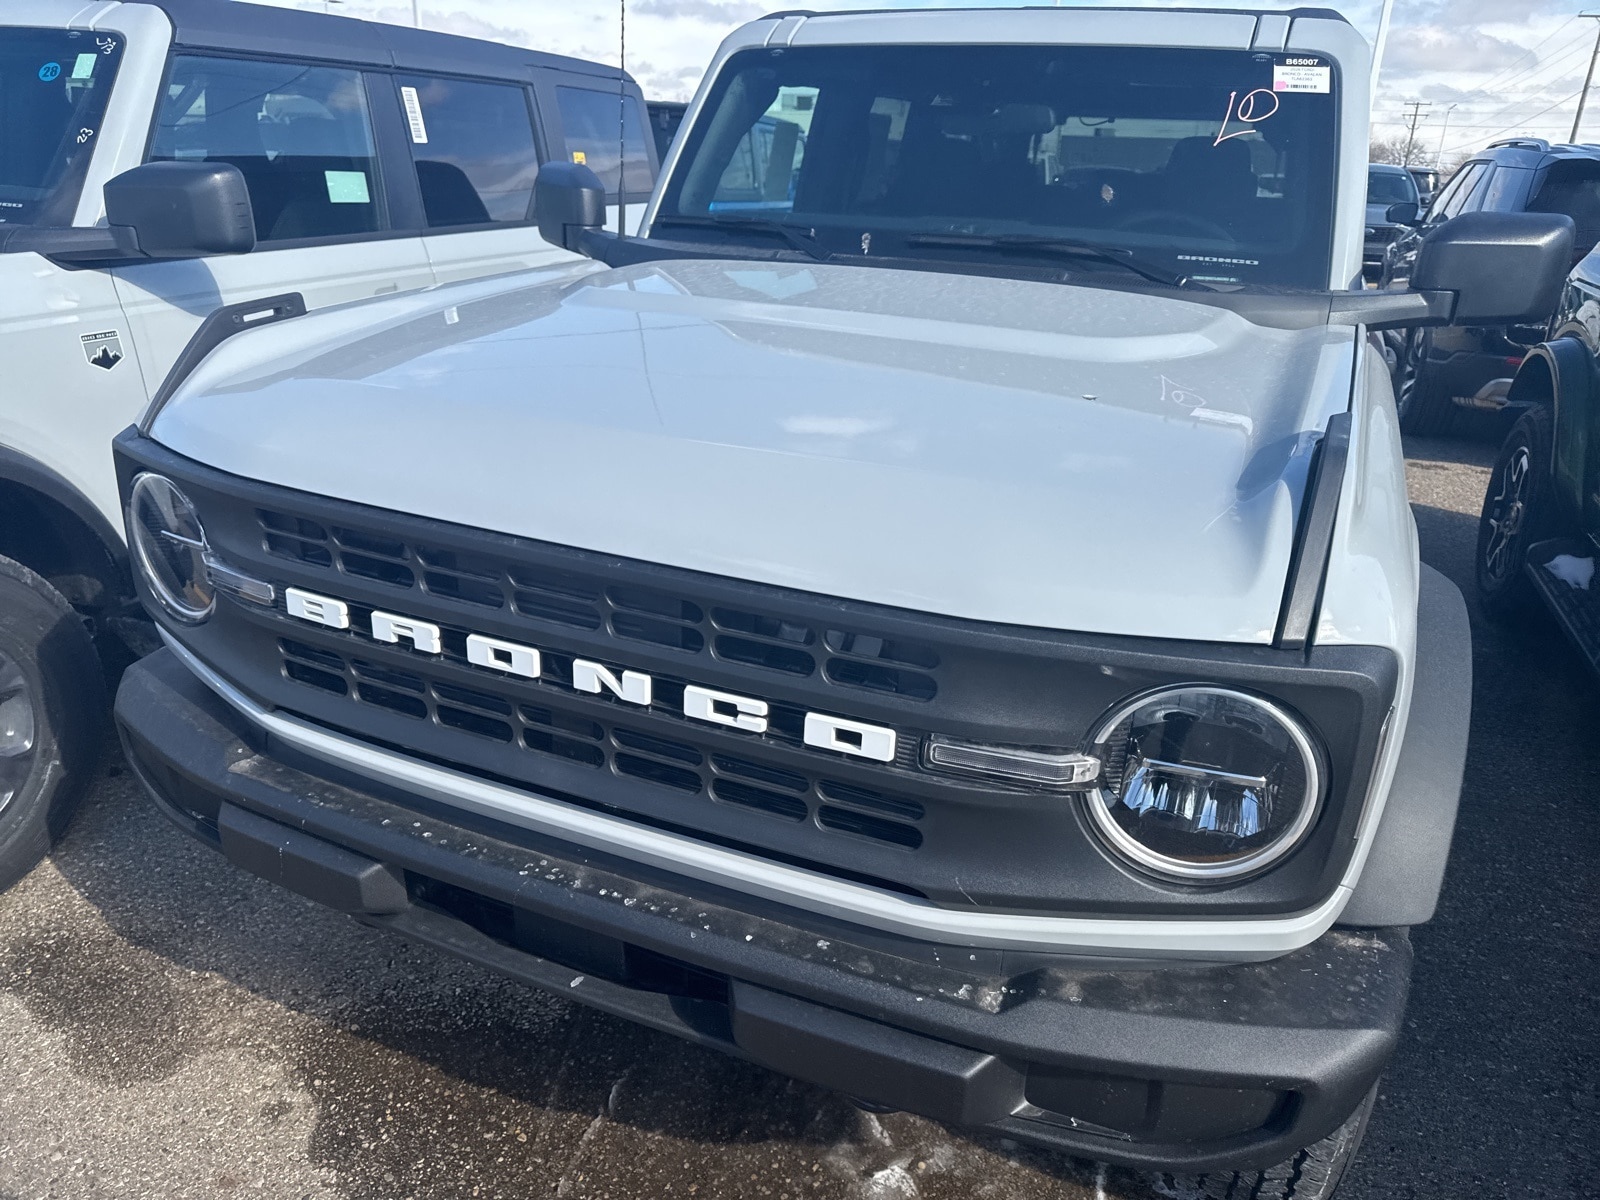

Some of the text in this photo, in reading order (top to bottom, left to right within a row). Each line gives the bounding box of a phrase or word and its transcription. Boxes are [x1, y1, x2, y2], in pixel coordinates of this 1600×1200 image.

[1285, 58, 1319, 66] B65007
[41, 65, 59, 78] 28
[1177, 255, 1259, 265] BRONCO
[285, 586, 897, 763] BRONCO
